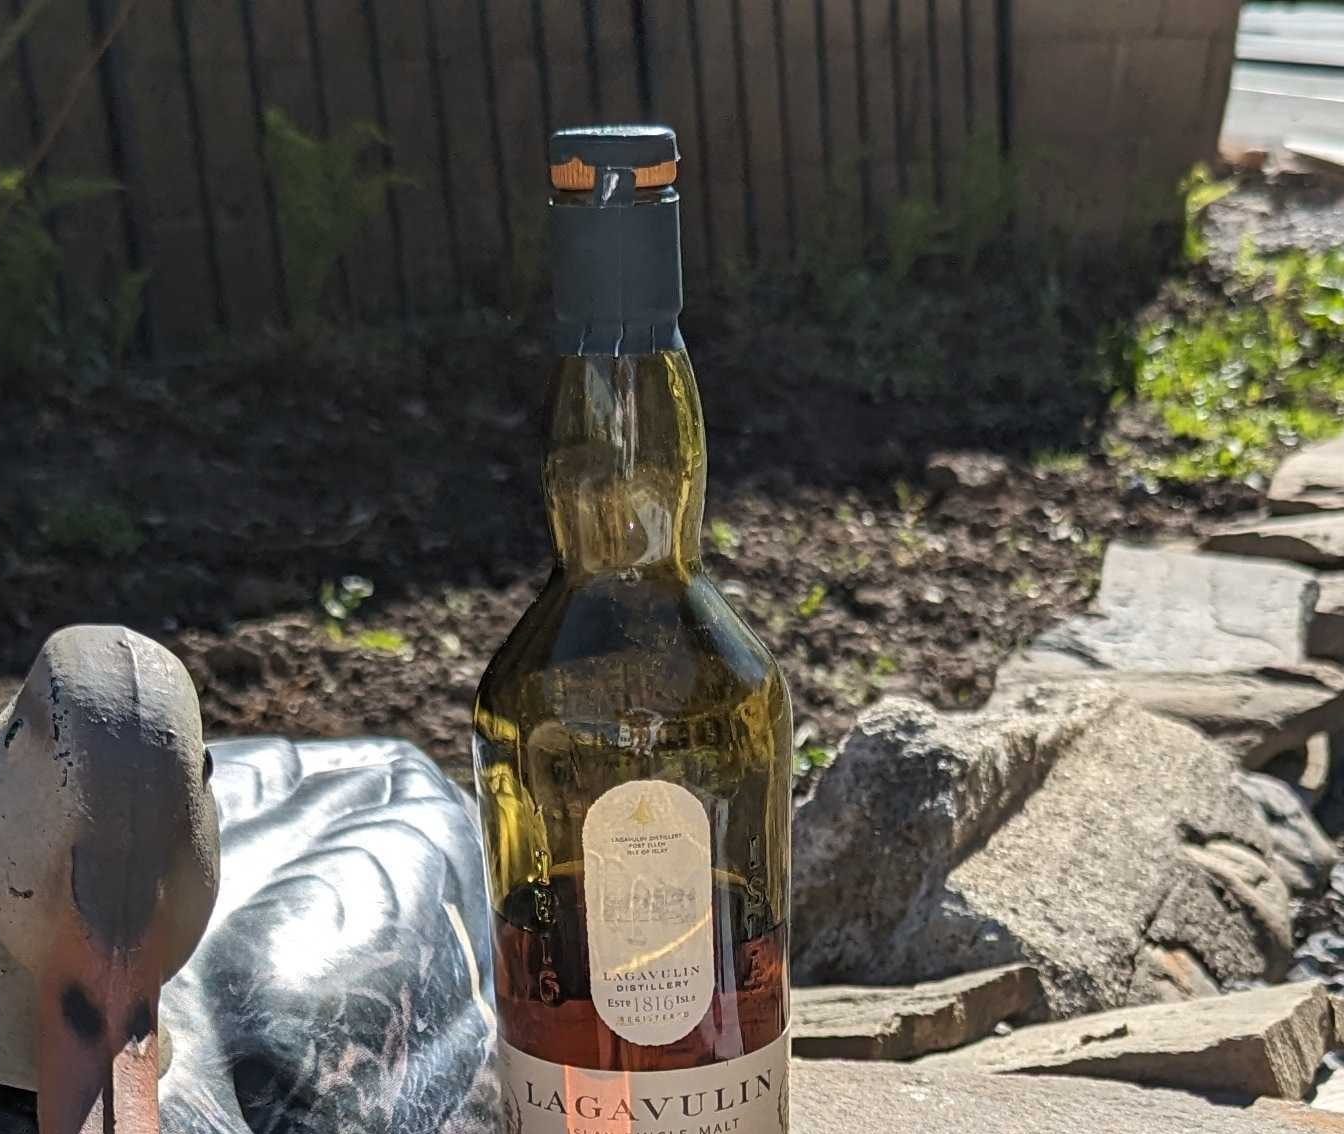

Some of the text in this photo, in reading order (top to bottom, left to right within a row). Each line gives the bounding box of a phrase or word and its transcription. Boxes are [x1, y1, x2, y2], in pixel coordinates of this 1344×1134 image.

[603, 965, 701, 982] LAGAVULIN
[616, 980, 690, 993] DISTILLERY
[634, 995, 674, 1013] 1816
[526, 1069, 773, 1122] LAGAVULIN
